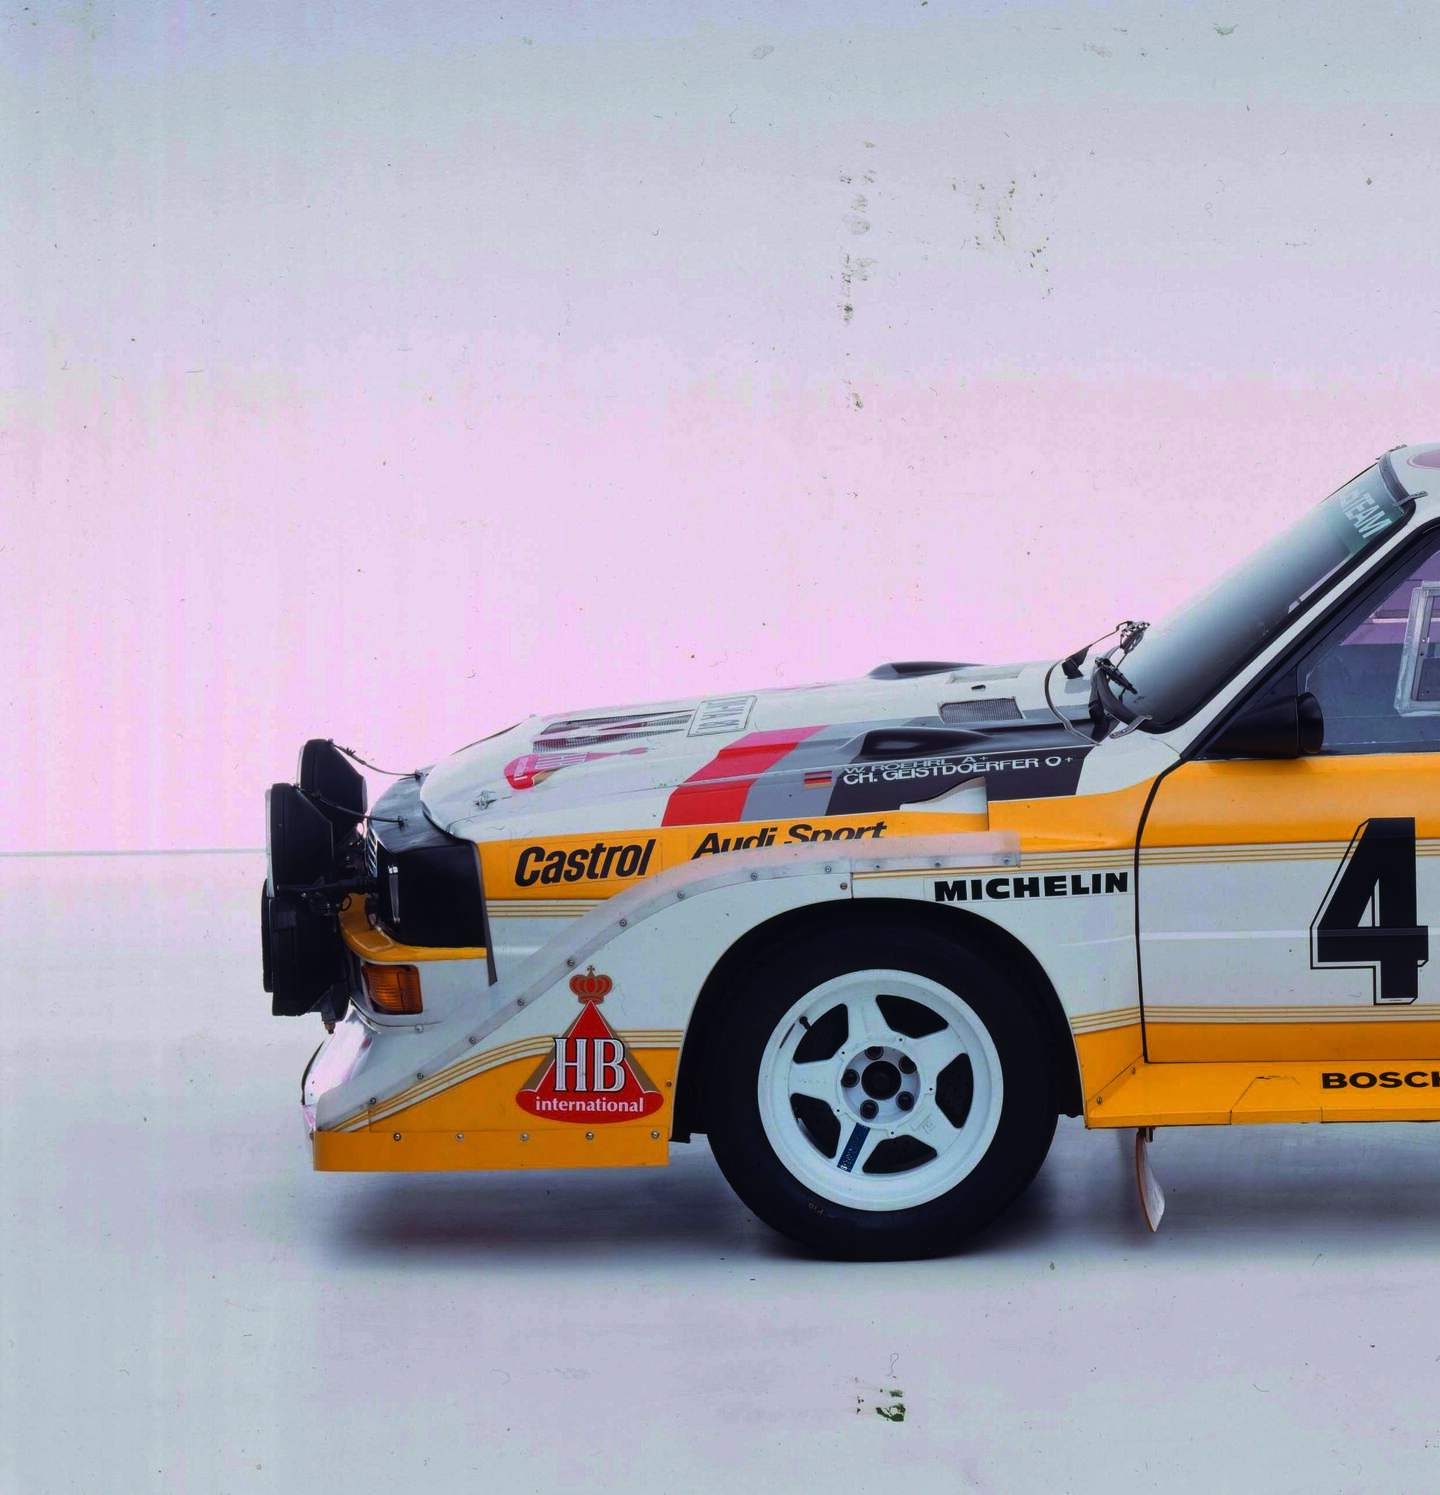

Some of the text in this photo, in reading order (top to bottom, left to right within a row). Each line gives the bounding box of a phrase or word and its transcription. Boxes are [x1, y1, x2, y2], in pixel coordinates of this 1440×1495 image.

[1342, 491, 1393, 539] TEAM
[843, 771, 878, 785] CH.
[882, 758, 1039, 781] GEISTDOERFER
[871, 759, 953, 772] ROEHRL
[690, 826, 779, 860] Audi
[514, 838, 657, 887] Castrol
[933, 871, 1128, 902] MICHELIN
[1309, 816, 1429, 1006] 4
[553, 1037, 627, 1093] HB
[535, 1095, 644, 1113] international
